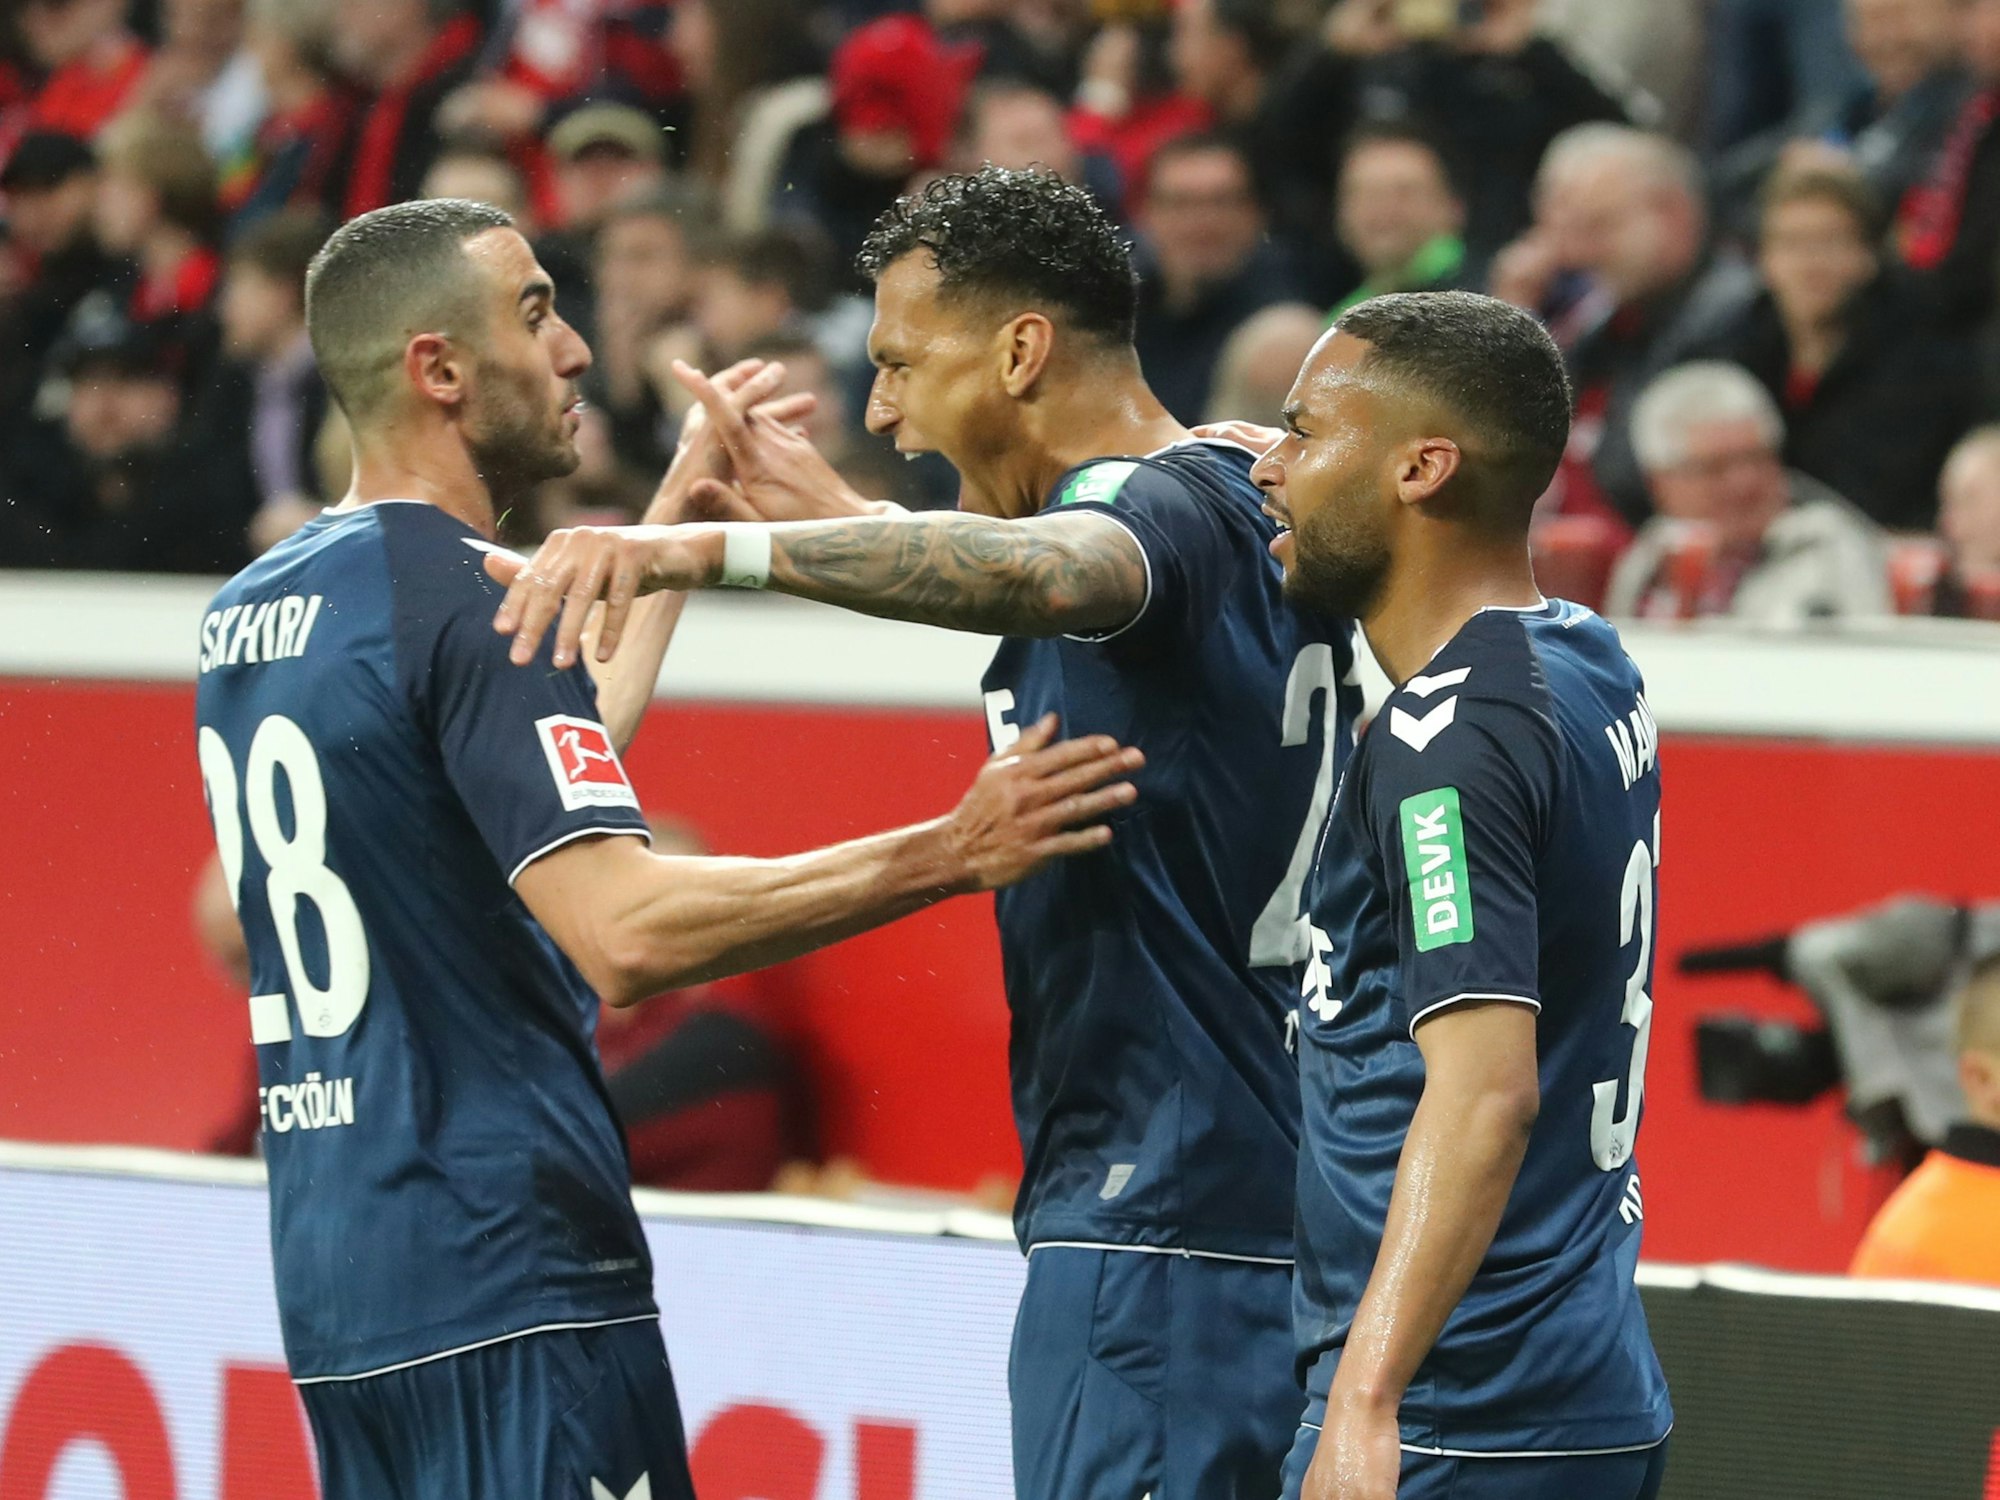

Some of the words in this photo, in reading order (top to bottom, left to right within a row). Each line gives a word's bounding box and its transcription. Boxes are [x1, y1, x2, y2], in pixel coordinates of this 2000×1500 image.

[200, 594, 323, 674] SKHIRI
[198, 713, 371, 1045] 28
[1413, 804, 1459, 935] DEVK
